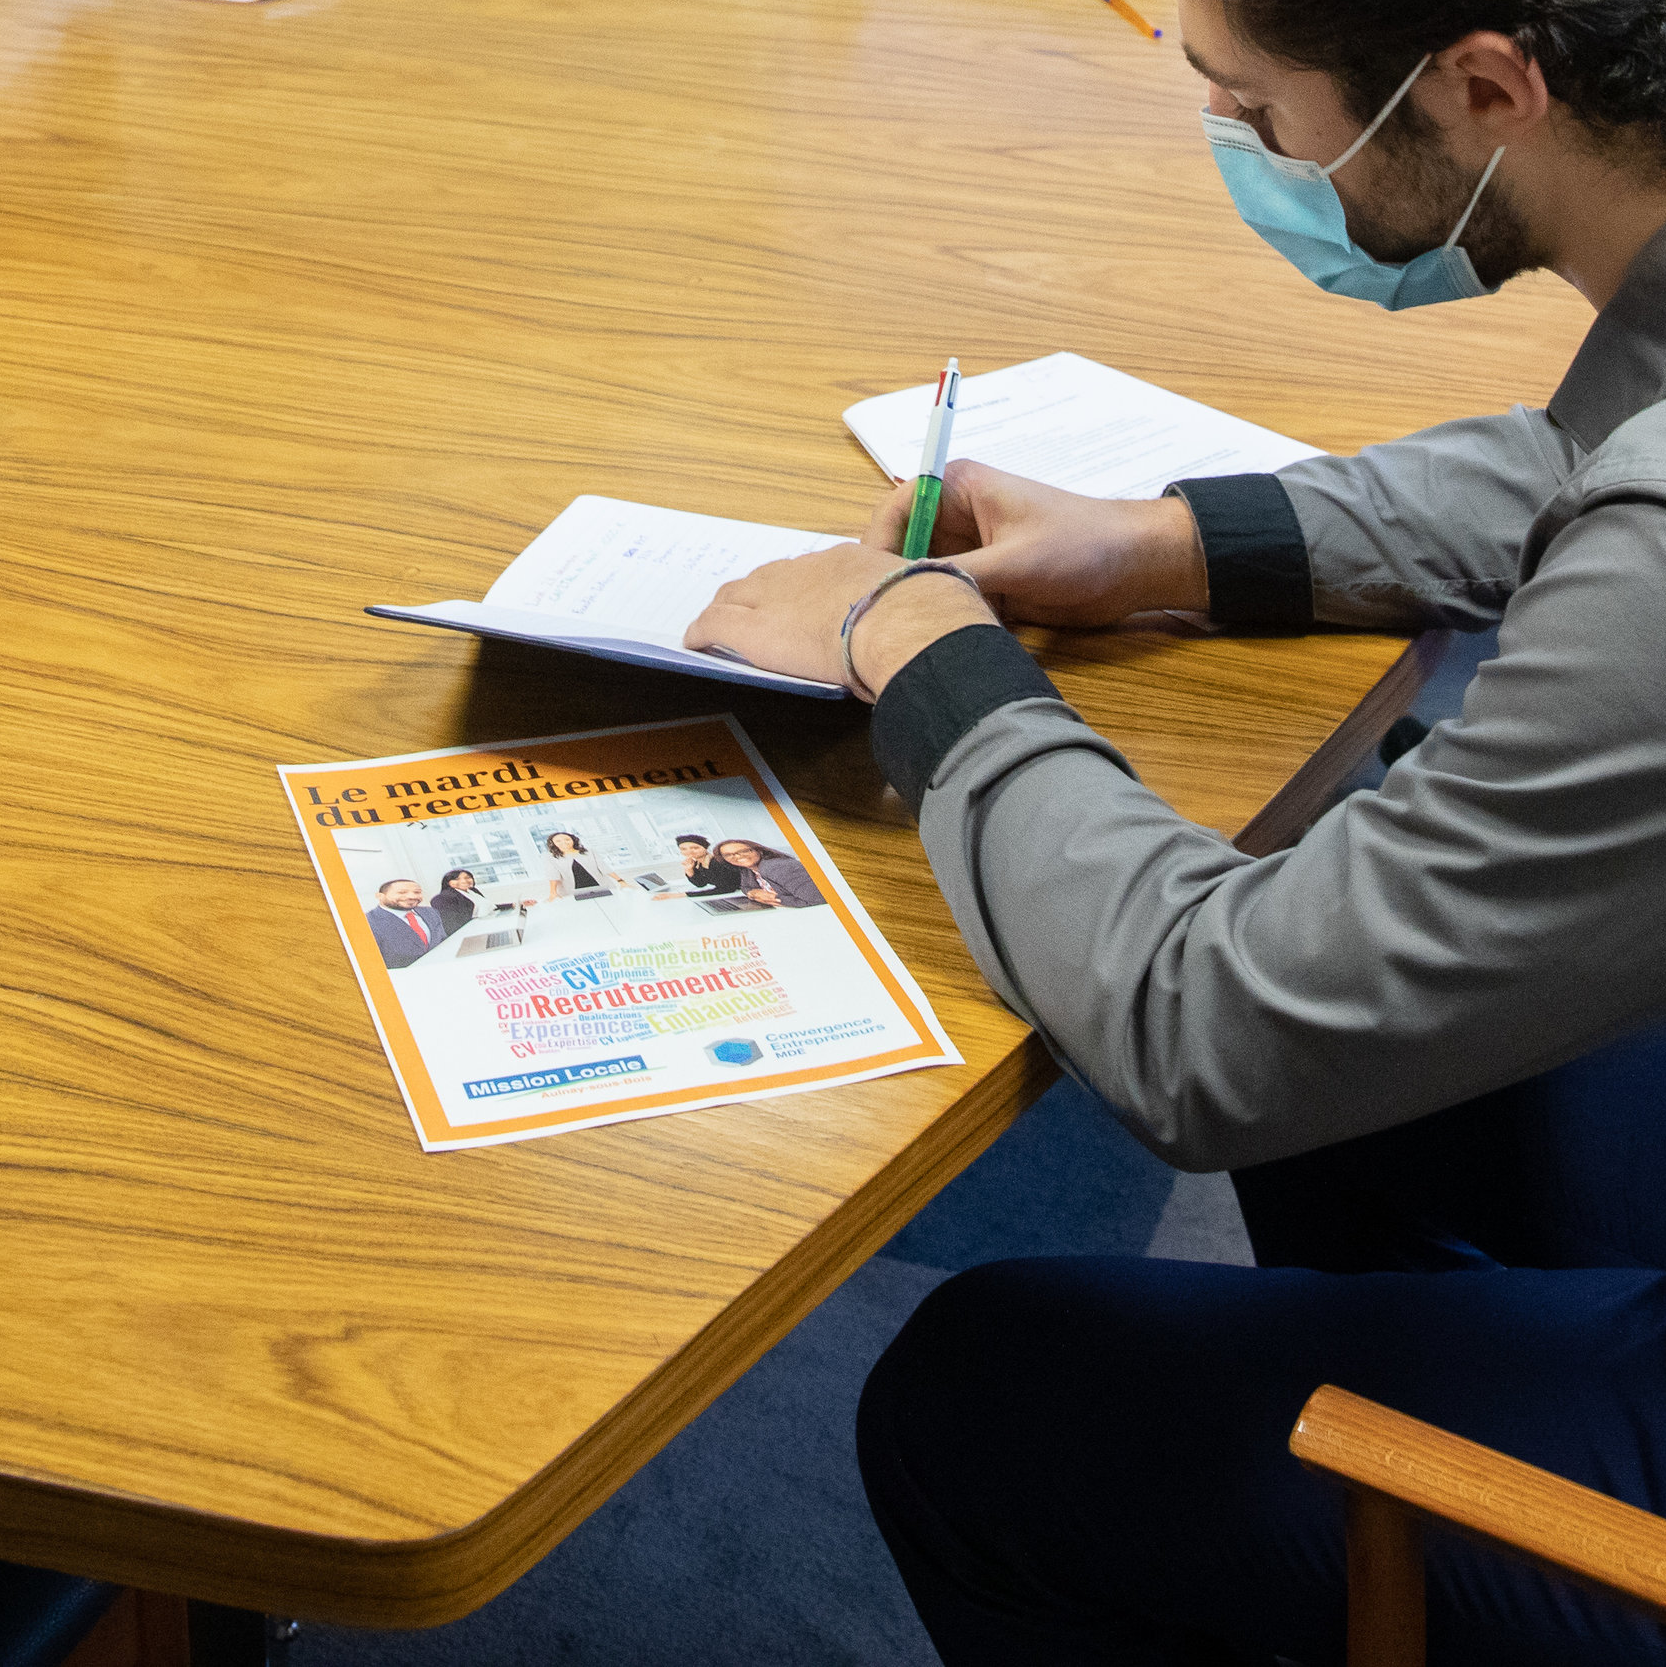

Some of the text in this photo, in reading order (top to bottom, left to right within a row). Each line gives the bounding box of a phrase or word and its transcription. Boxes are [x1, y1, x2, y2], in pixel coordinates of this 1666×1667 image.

[303, 758, 545, 806] Le mardi
[315, 758, 726, 828] du recrutement
[702, 934, 748, 950] Profil
[485, 964, 539, 985] Salaire
[542, 953, 596, 974] Formation
[561, 964, 601, 991] CV
[734, 967, 774, 987] CDD
[530, 967, 740, 1018] Recrutement
[497, 1003, 531, 1020] CDI
[645, 988, 779, 1034] Embauche
[599, 1036, 614, 1045] CV
[765, 1017, 873, 1043] Convergence
[770, 1023, 886, 1051] Entrepreneurs
[511, 1041, 536, 1059] CV
[548, 1037, 598, 1049] Expertise
[775, 1048, 807, 1060] MDE
[470, 1059, 642, 1098] Mission Locale
[540, 1075, 653, 1100] Aulnay-sous-Bois
